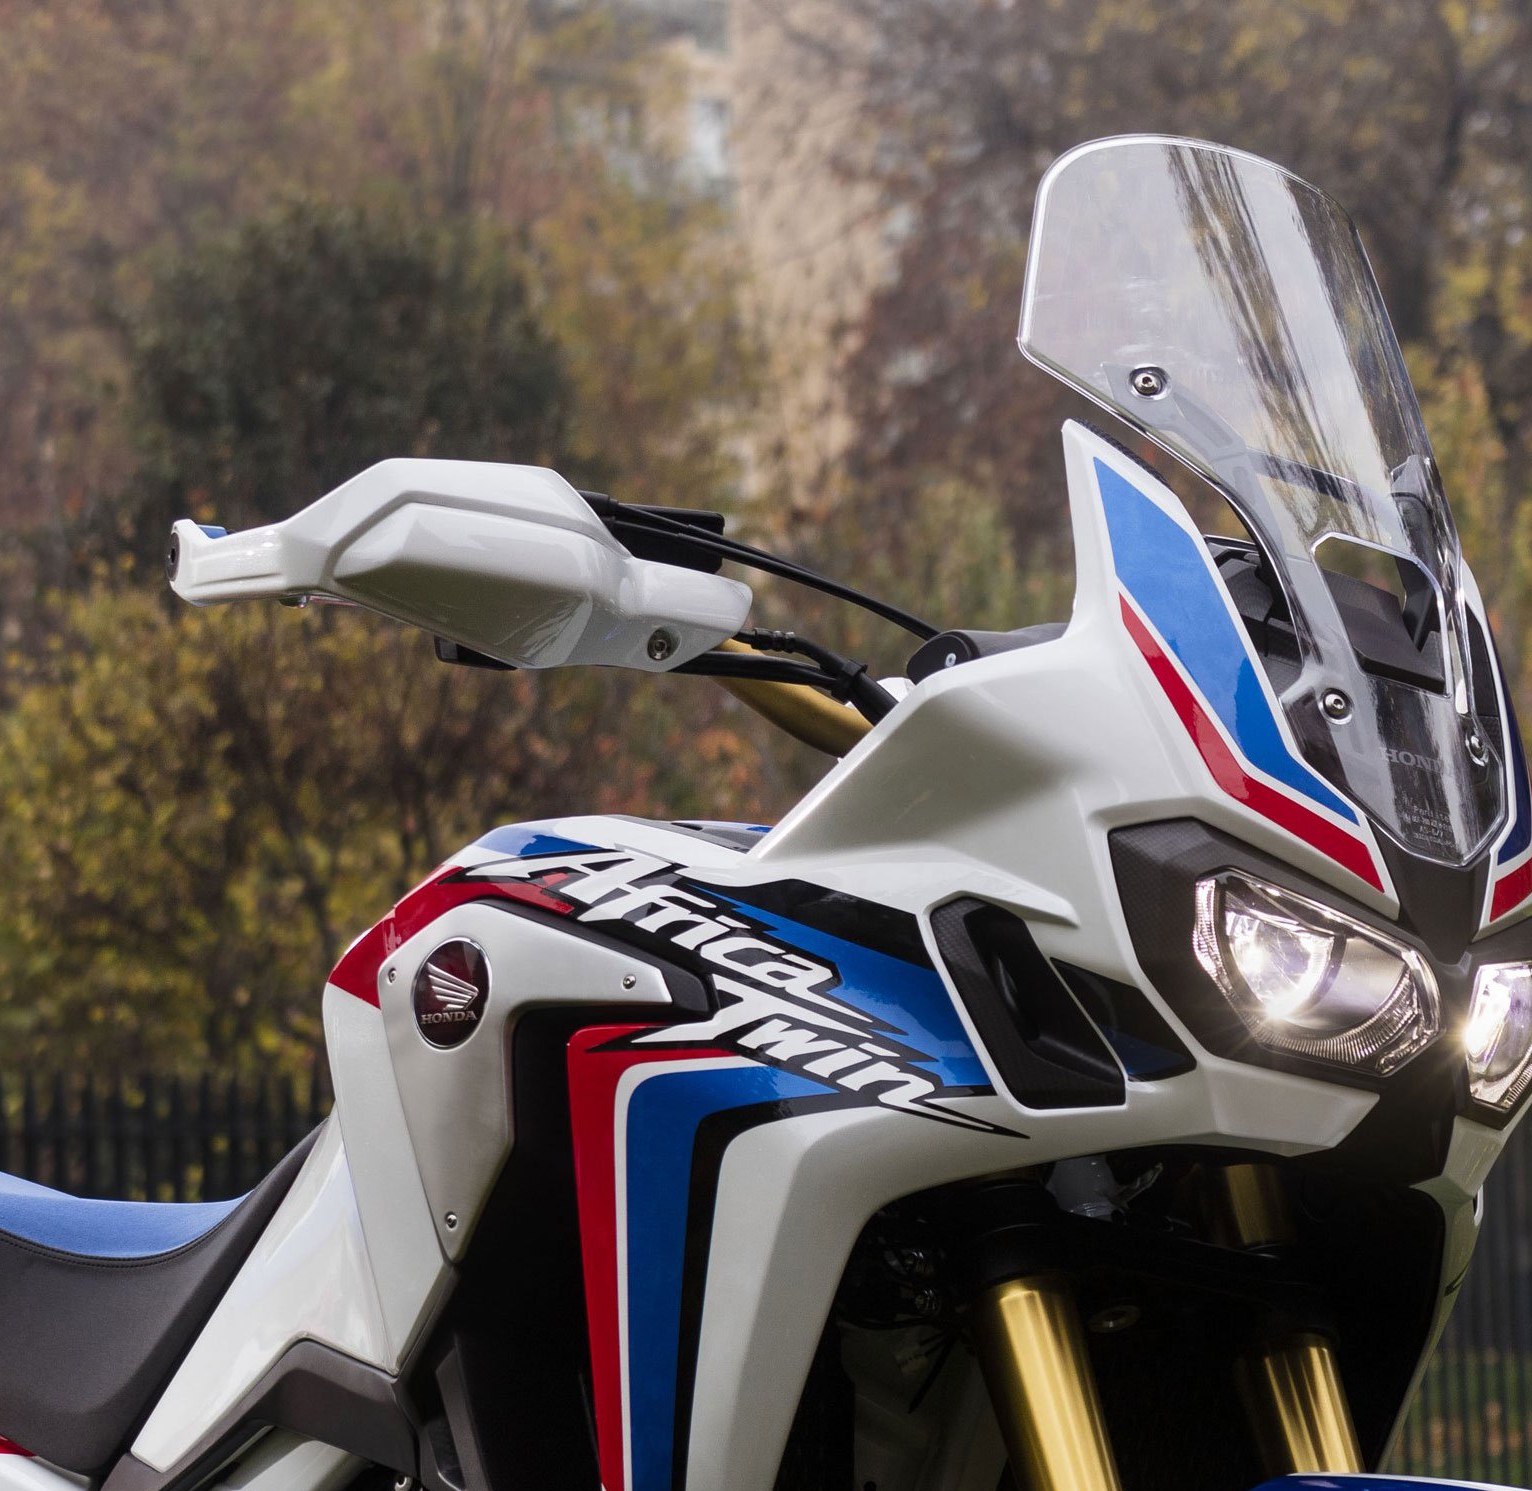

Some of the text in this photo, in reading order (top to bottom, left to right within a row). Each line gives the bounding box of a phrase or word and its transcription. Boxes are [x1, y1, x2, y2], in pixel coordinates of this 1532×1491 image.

[465, 849, 875, 1024] Africa
[420, 1010, 478, 1026] HONDA
[632, 972, 1000, 1132] Twin
